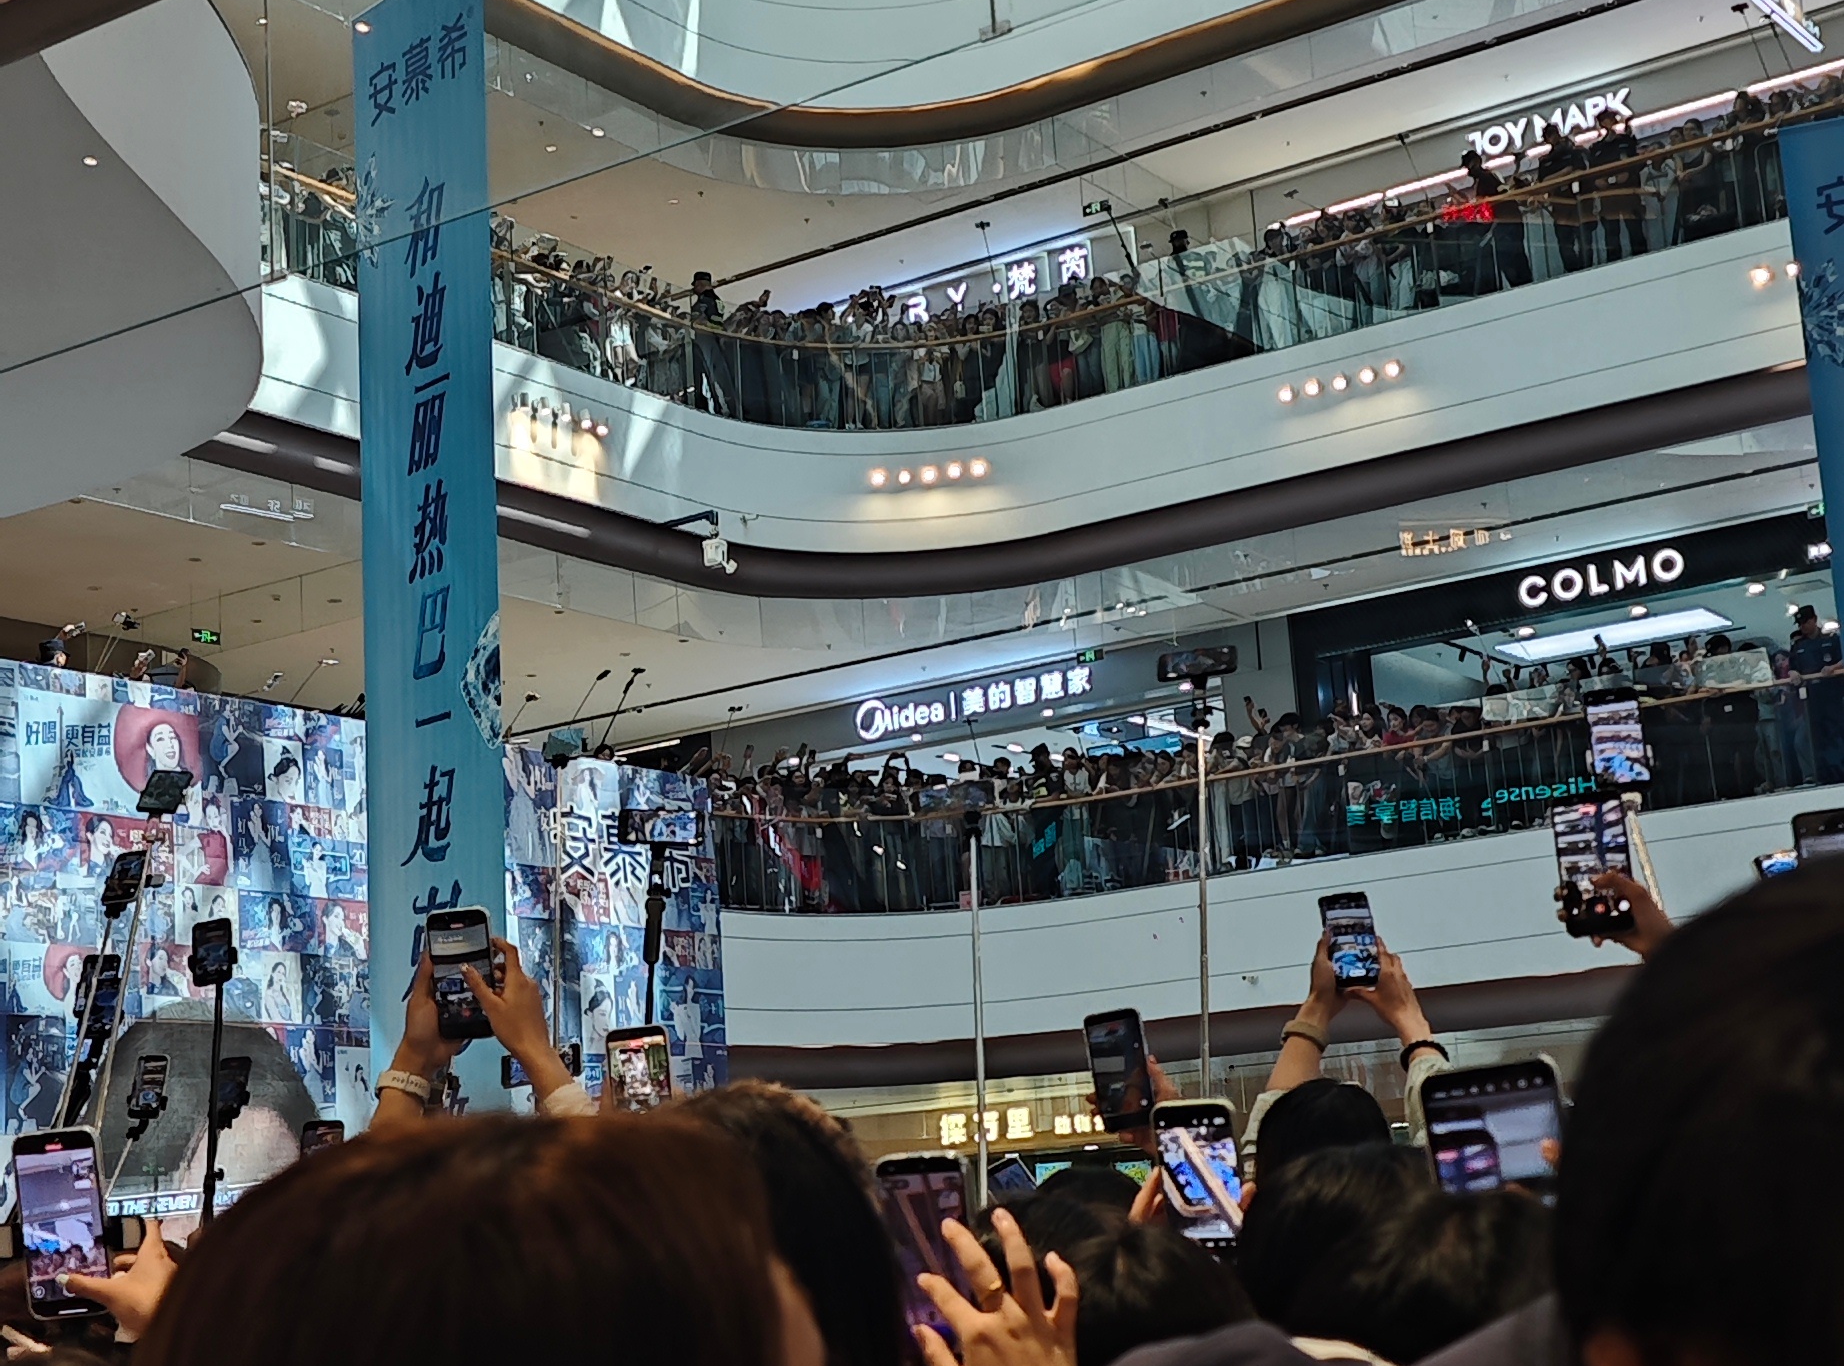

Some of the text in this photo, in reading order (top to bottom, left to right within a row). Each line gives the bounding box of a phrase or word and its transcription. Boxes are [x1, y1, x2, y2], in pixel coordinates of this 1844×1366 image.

[367, 12, 468, 127] 安慕希
[1466, 87, 1633, 156] JOY MARK
[1517, 547, 1685, 609] COLMO
[25, 721, 111, 748] 好喝 更有益
[855, 666, 1092, 741] Midea 美的智慧家
[122, 1198, 150, 1216] THE
